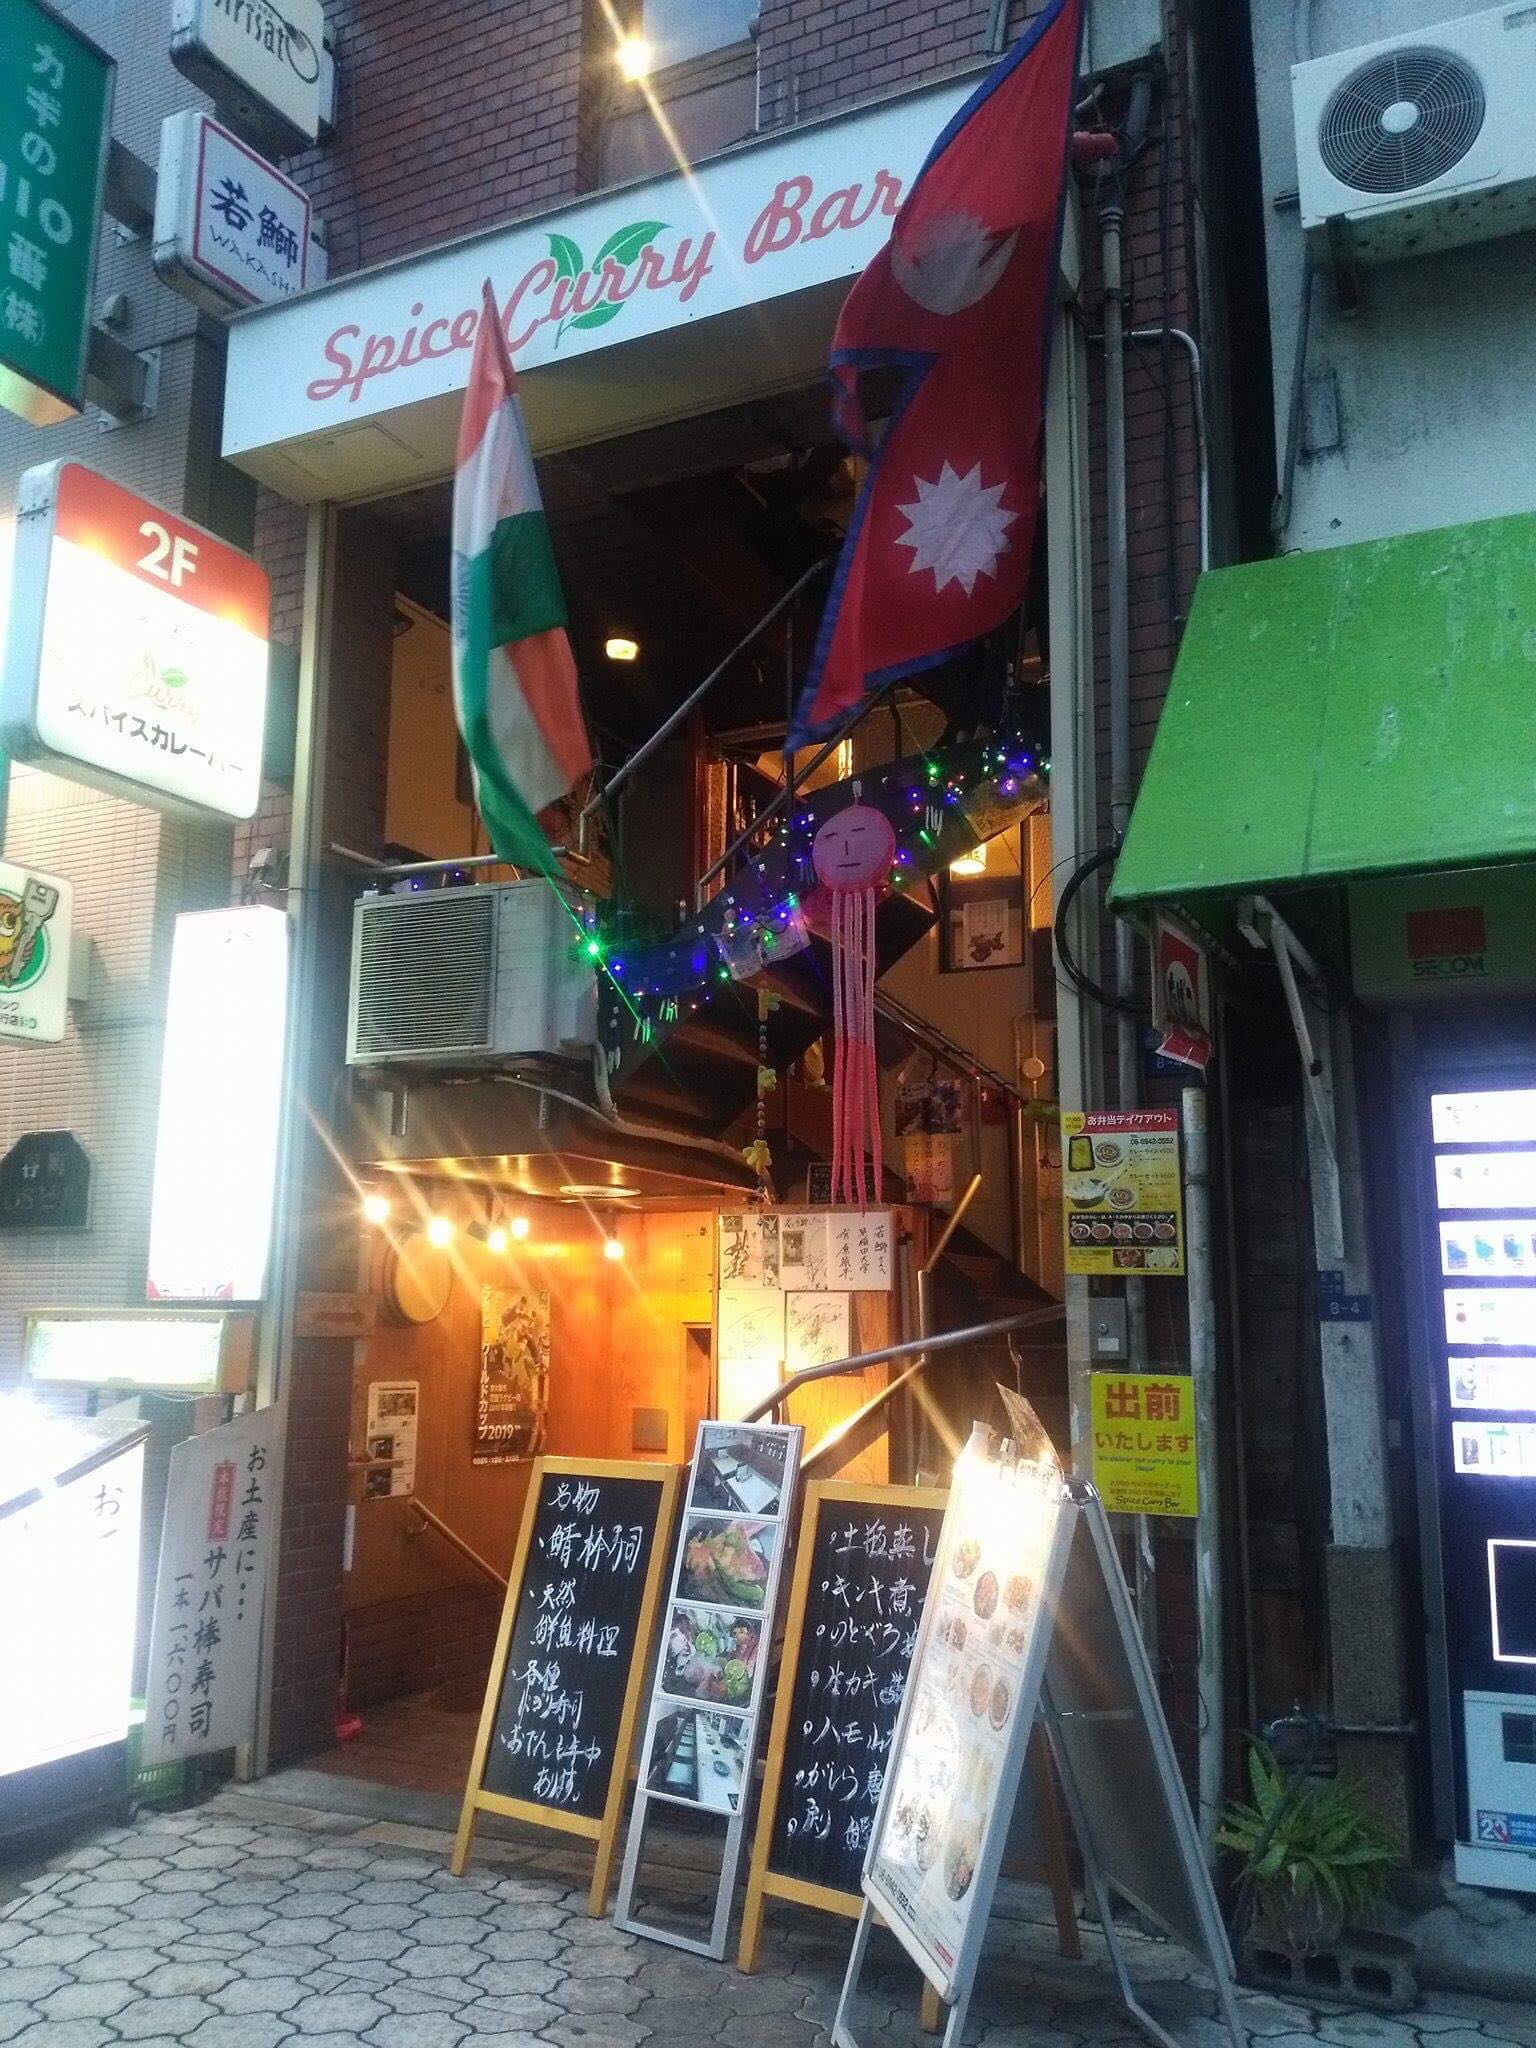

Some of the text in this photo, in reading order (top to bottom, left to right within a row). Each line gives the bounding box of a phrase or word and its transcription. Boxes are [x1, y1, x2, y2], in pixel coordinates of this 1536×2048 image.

[306, 168, 904, 402] Spice Curry Bar
[135, 520, 199, 588] 2F
[1087, 1113, 1173, 1126] お弁当テイクアウト
[1330, 1301, 1360, 1315] 8-4
[478, 1344, 491, 1440] ワールドカップ
[1104, 1381, 1181, 1422] 出前
[1095, 1432, 1193, 1454] いたします
[548, 1481, 600, 1515] 名物
[1115, 1495, 1141, 1505] Spice
[1165, 1497, 1181, 1509] Bar
[835, 1518, 935, 1566] 土瓶蒸し
[537, 1578, 577, 1609] 天然
[831, 1574, 926, 1617] キンキ煮
[188, 1546, 228, 1738] サバ棒寿司
[530, 1609, 620, 1656] 鮮魚料理
[515, 1659, 560, 1692] 各種
[812, 1714, 898, 1754] ハモ山
